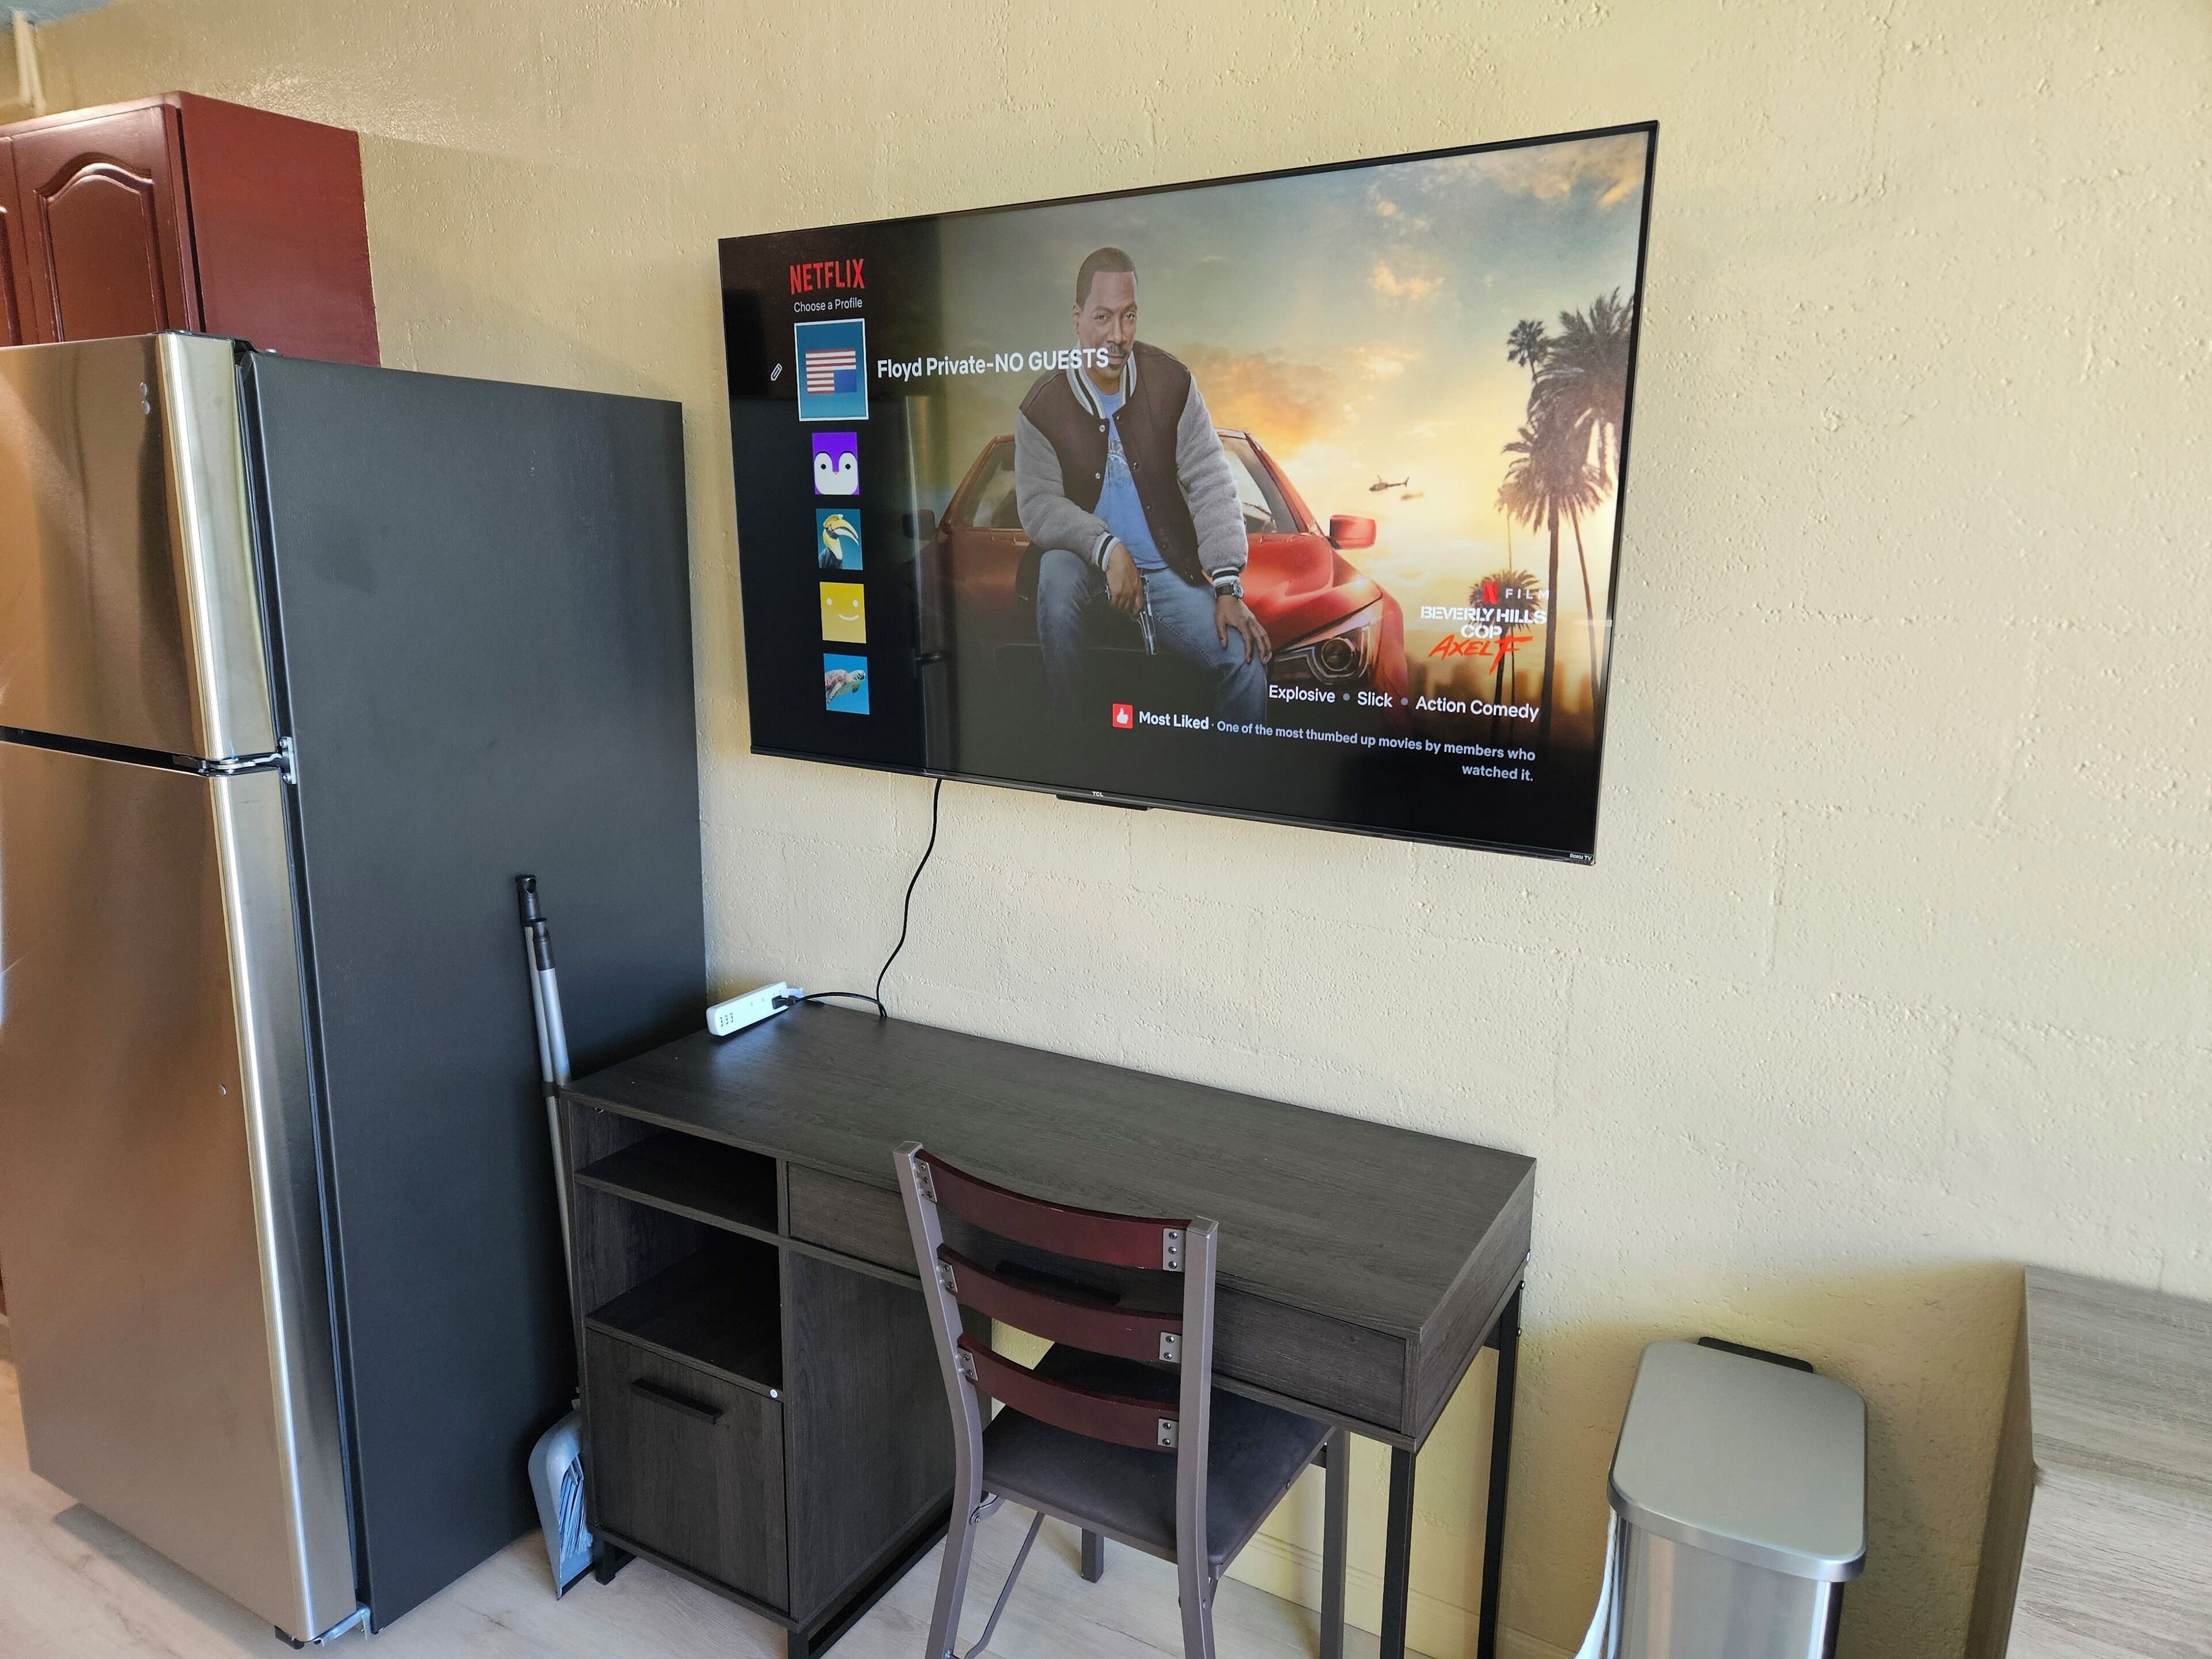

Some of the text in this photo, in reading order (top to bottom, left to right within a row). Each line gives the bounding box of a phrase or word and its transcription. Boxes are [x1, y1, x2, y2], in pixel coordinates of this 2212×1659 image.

[790, 258, 865, 295] NETFLIX
[794, 297, 863, 313] Choose a Profile
[877, 347, 1109, 382] Floyd Private-NO GUESTS
[1505, 588, 1550, 600] FILM
[1420, 605, 1548, 625] BEVERLY HILLS
[1460, 624, 1503, 639] COP
[1427, 634, 1533, 676] AXEL F
[1268, 684, 1539, 722] Explosive Slick Action Comedy
[1139, 711, 1536, 762] Most Liked One of the most thumbed up movies by members who
[1462, 765, 1533, 782] watched it.
